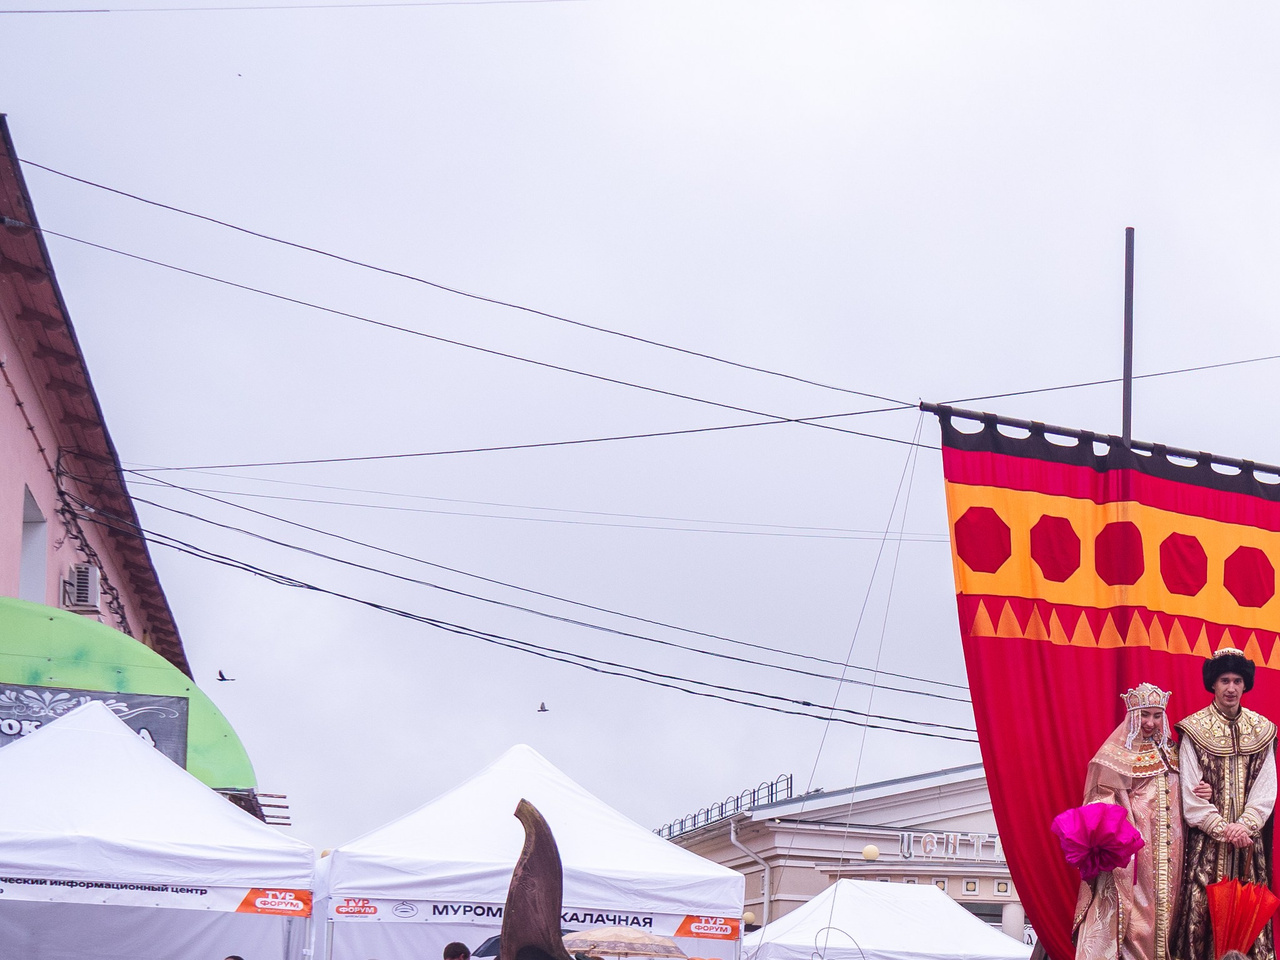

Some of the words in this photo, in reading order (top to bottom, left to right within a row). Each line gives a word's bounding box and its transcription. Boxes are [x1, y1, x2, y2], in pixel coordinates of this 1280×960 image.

[50, 879, 169, 892] информационный
[171, 886, 208, 895] центр
[265, 891, 295, 901] ТУР
[259, 900, 300, 909] ФОРУМ
[344, 898, 369, 906] ТУР
[339, 906, 375, 914] ФОРУМ
[433, 904, 503, 918] МУРОМ
[700, 916, 725, 925] ТУР
[694, 925, 728, 933] ФОРУМ
